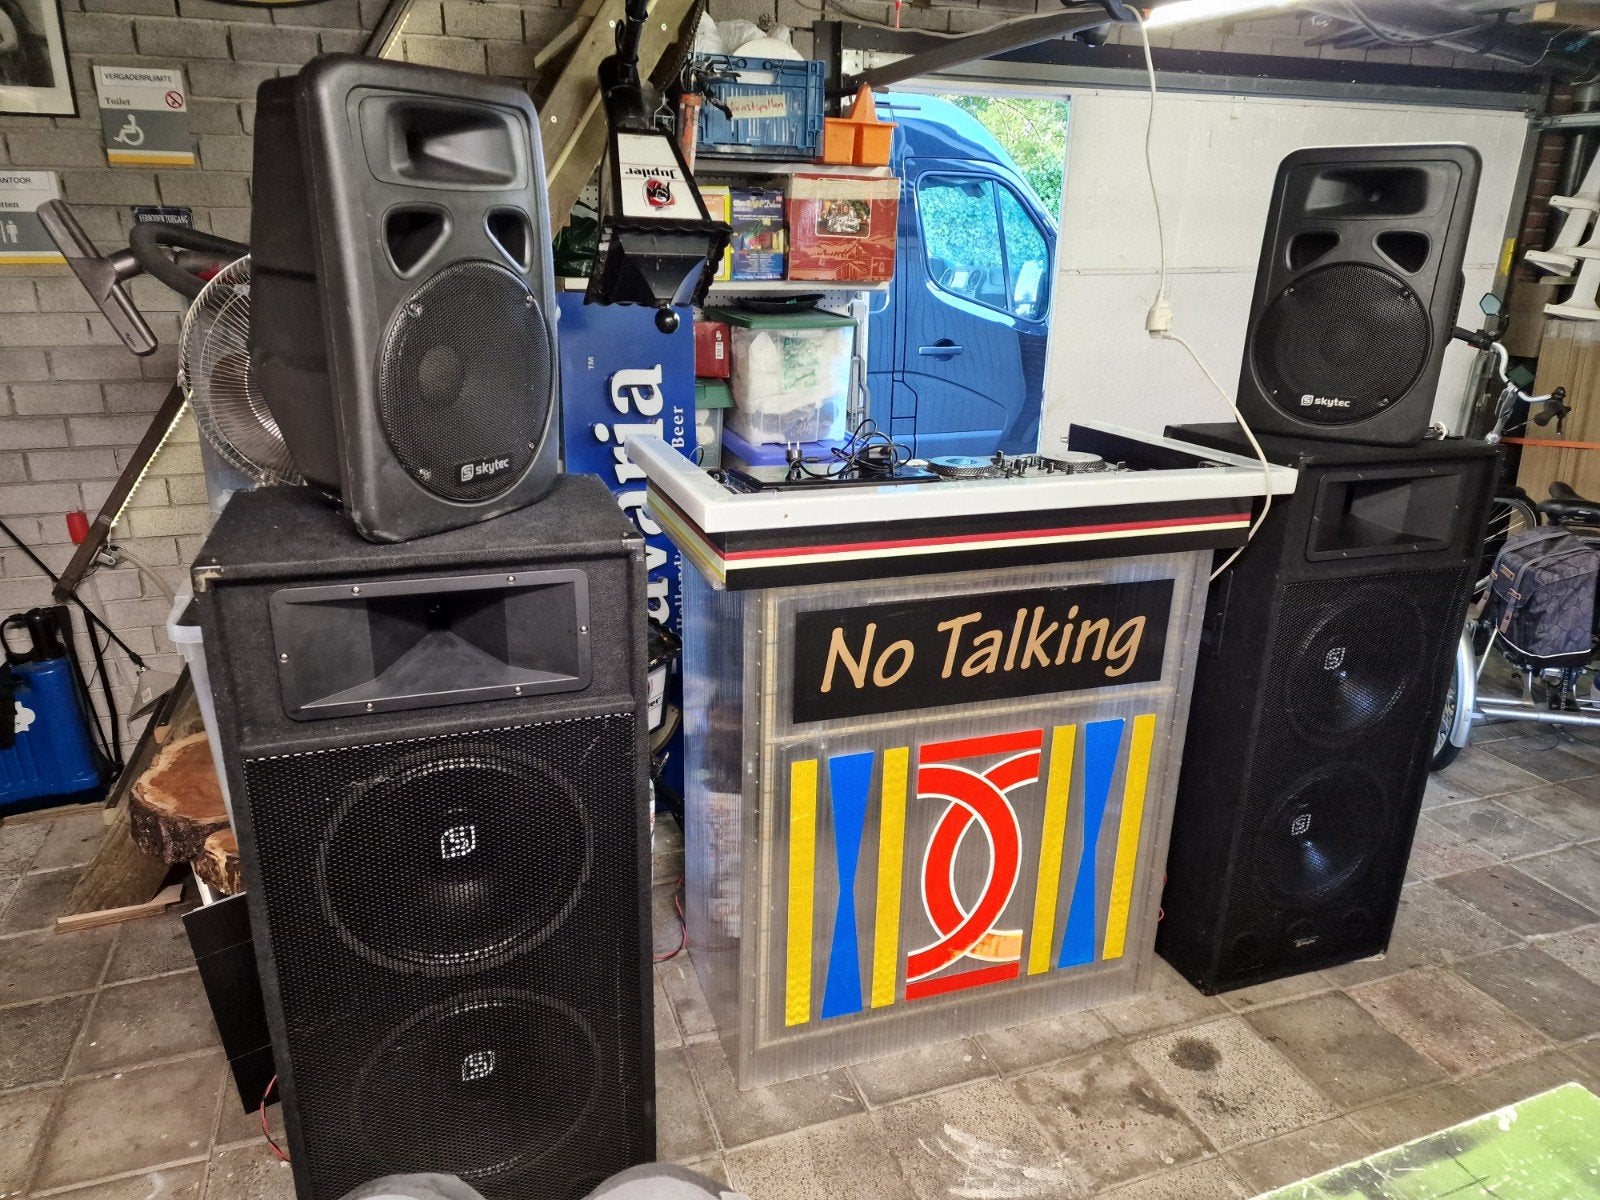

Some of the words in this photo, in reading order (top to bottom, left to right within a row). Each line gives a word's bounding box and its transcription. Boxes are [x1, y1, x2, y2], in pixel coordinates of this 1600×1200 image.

[104, 96, 131, 106] Toilet
[625, 167, 678, 180] Jupiler
[588, 356, 595, 370] TM
[1314, 397, 1351, 407] skytec
[671, 405, 685, 448] Beer
[475, 459, 509, 475] skytec
[820, 622, 914, 693] No
[937, 605, 1147, 678] Talking
